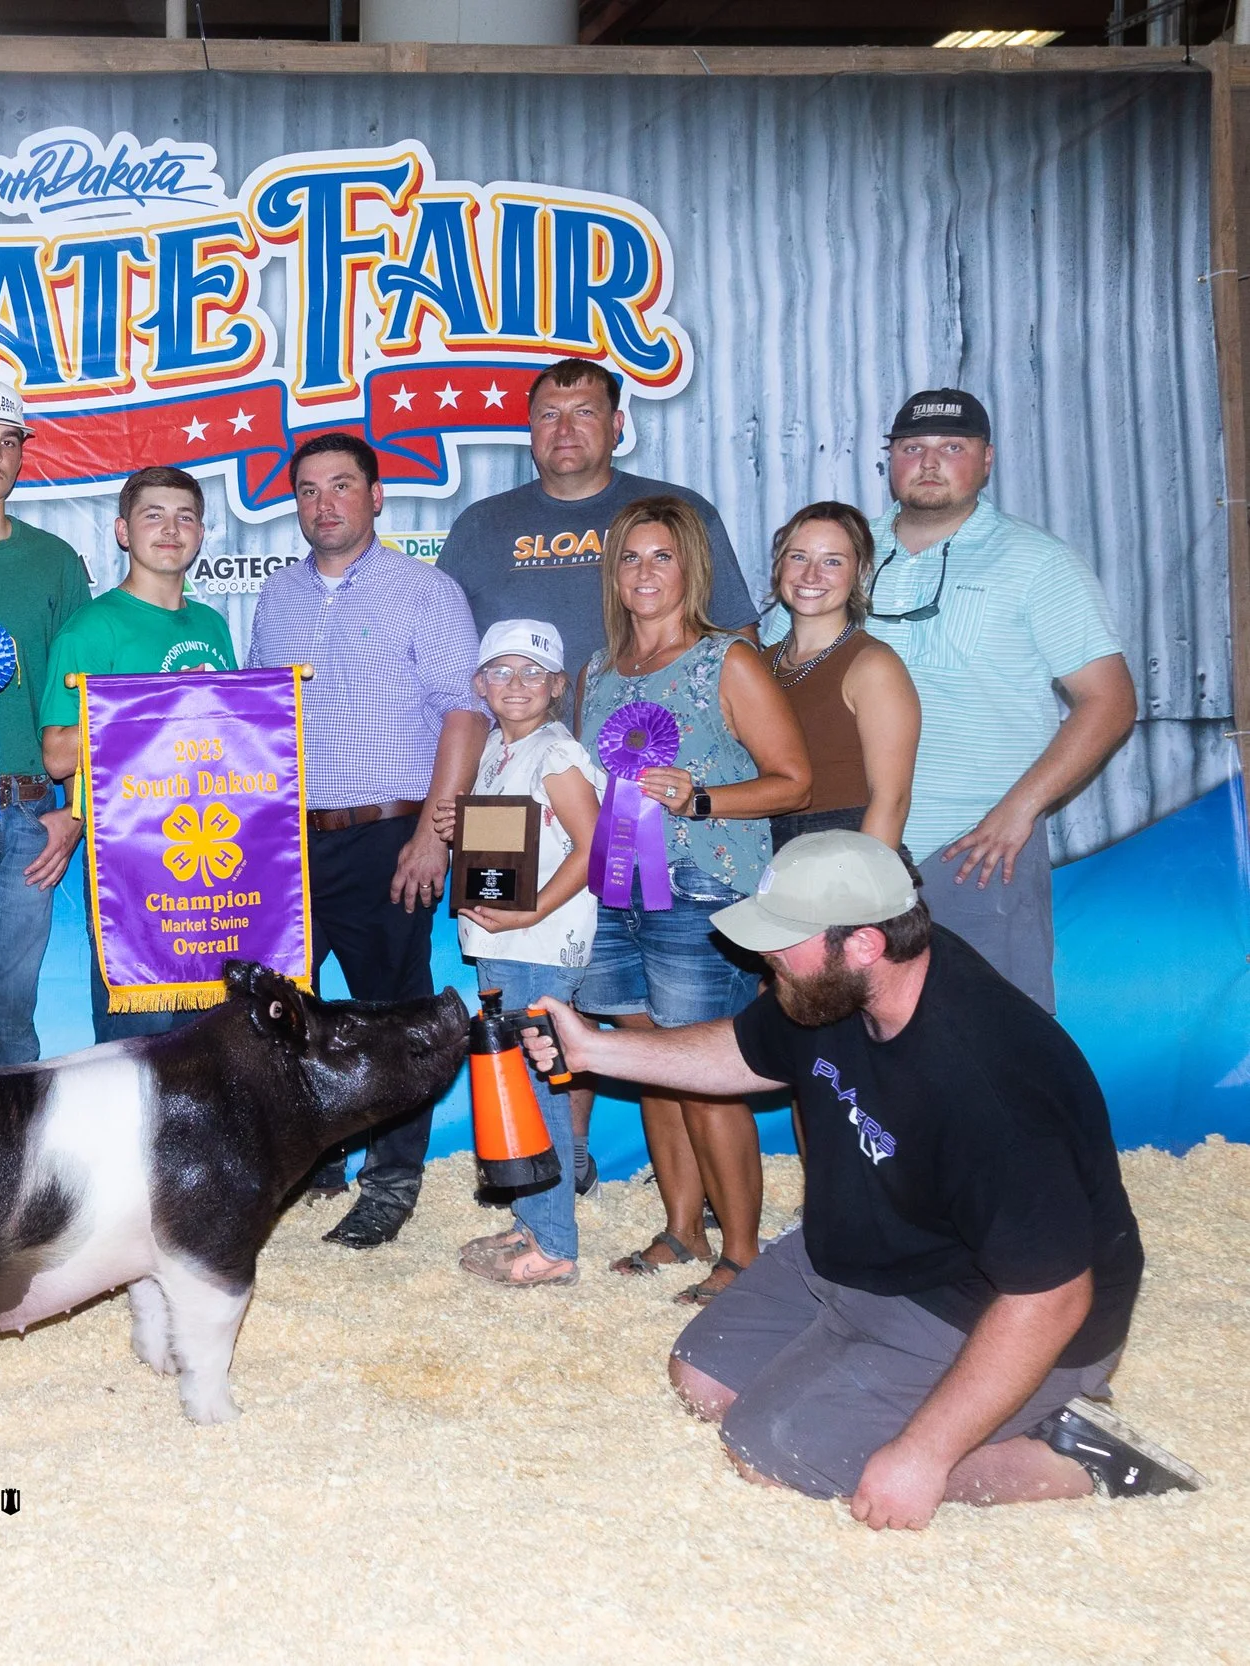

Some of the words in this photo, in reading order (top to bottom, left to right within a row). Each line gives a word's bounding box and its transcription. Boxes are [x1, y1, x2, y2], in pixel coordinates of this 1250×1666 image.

[30, 139, 212, 207] Dakota
[250, 151, 682, 405] FAIR
[913, 403, 934, 414] TEAM
[515, 560, 546, 568] MAKE
[531, 633, 550, 652] W/C
[174, 738, 224, 762] 2023
[121, 774, 191, 800] South
[197, 769, 279, 796] Dakota
[145, 890, 262, 912] Champion
[161, 918, 207, 933] Market
[210, 915, 250, 931] Swine
[173, 934, 239, 956] Overall
